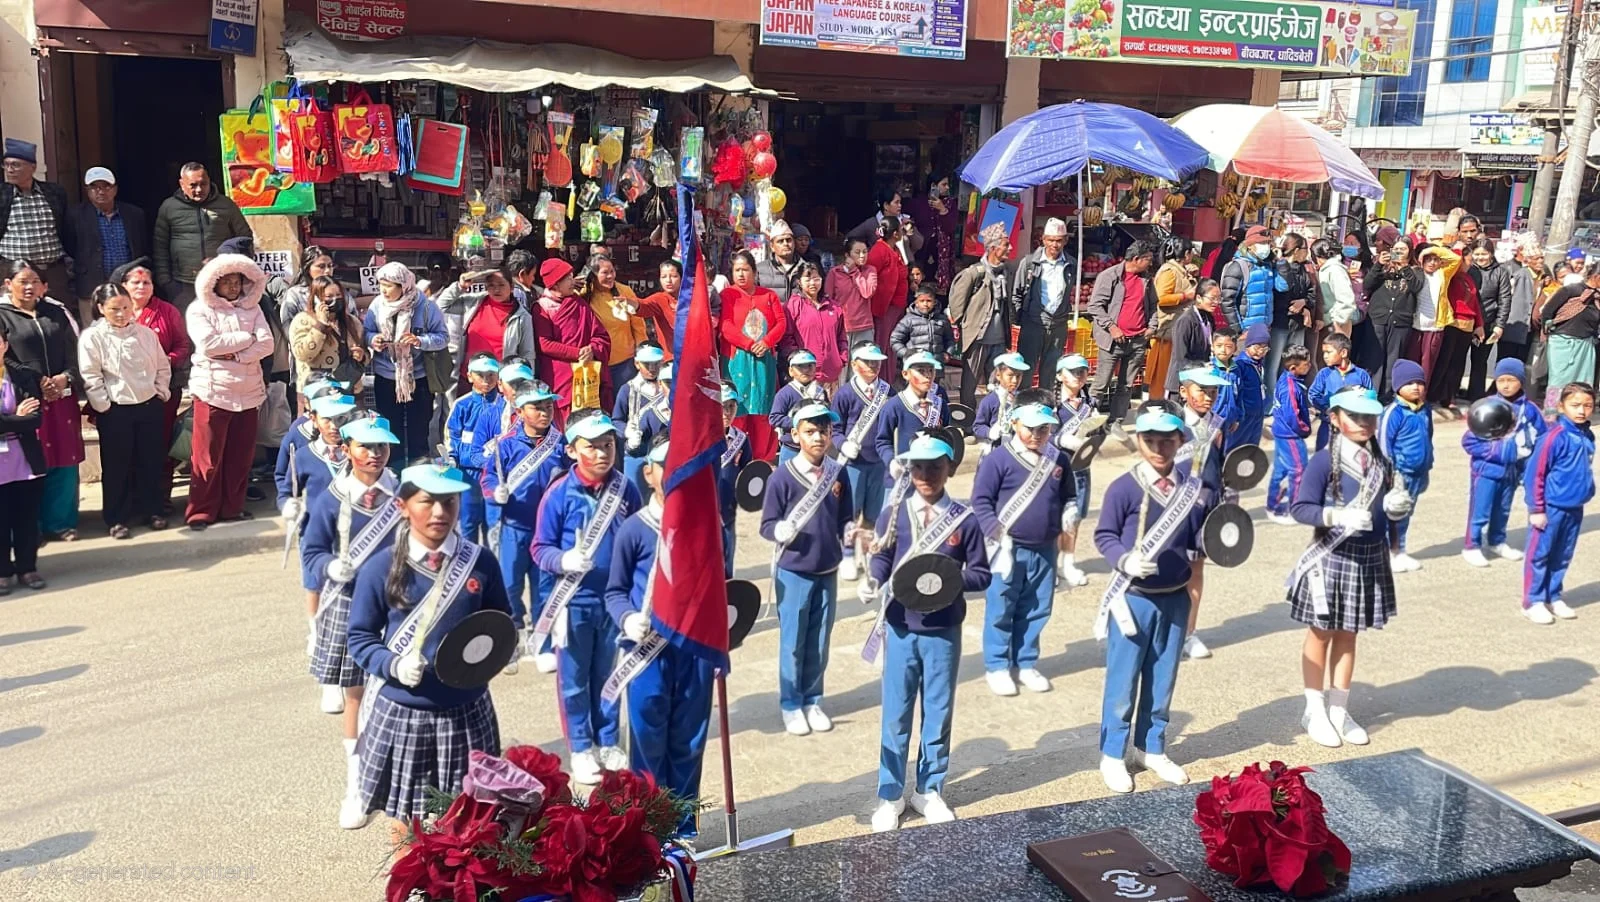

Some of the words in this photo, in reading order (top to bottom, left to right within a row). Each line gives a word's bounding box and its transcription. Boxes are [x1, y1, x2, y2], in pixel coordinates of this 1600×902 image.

[842, 0, 884, 9] JAPANESE
[893, 3, 926, 12] KOREAN
[766, 11, 814, 35] JAPAN
[833, 8, 877, 20] LANGUAGE
[879, 10, 912, 23] COURSE
[1126, 3, 1192, 32] सन्ध्या
[1199, 7, 1319, 41] इन्टरप्राईजेज
[819, 22, 844, 32] STUDY
[851, 25, 874, 36] WORK
[880, 27, 898, 37] VISA
